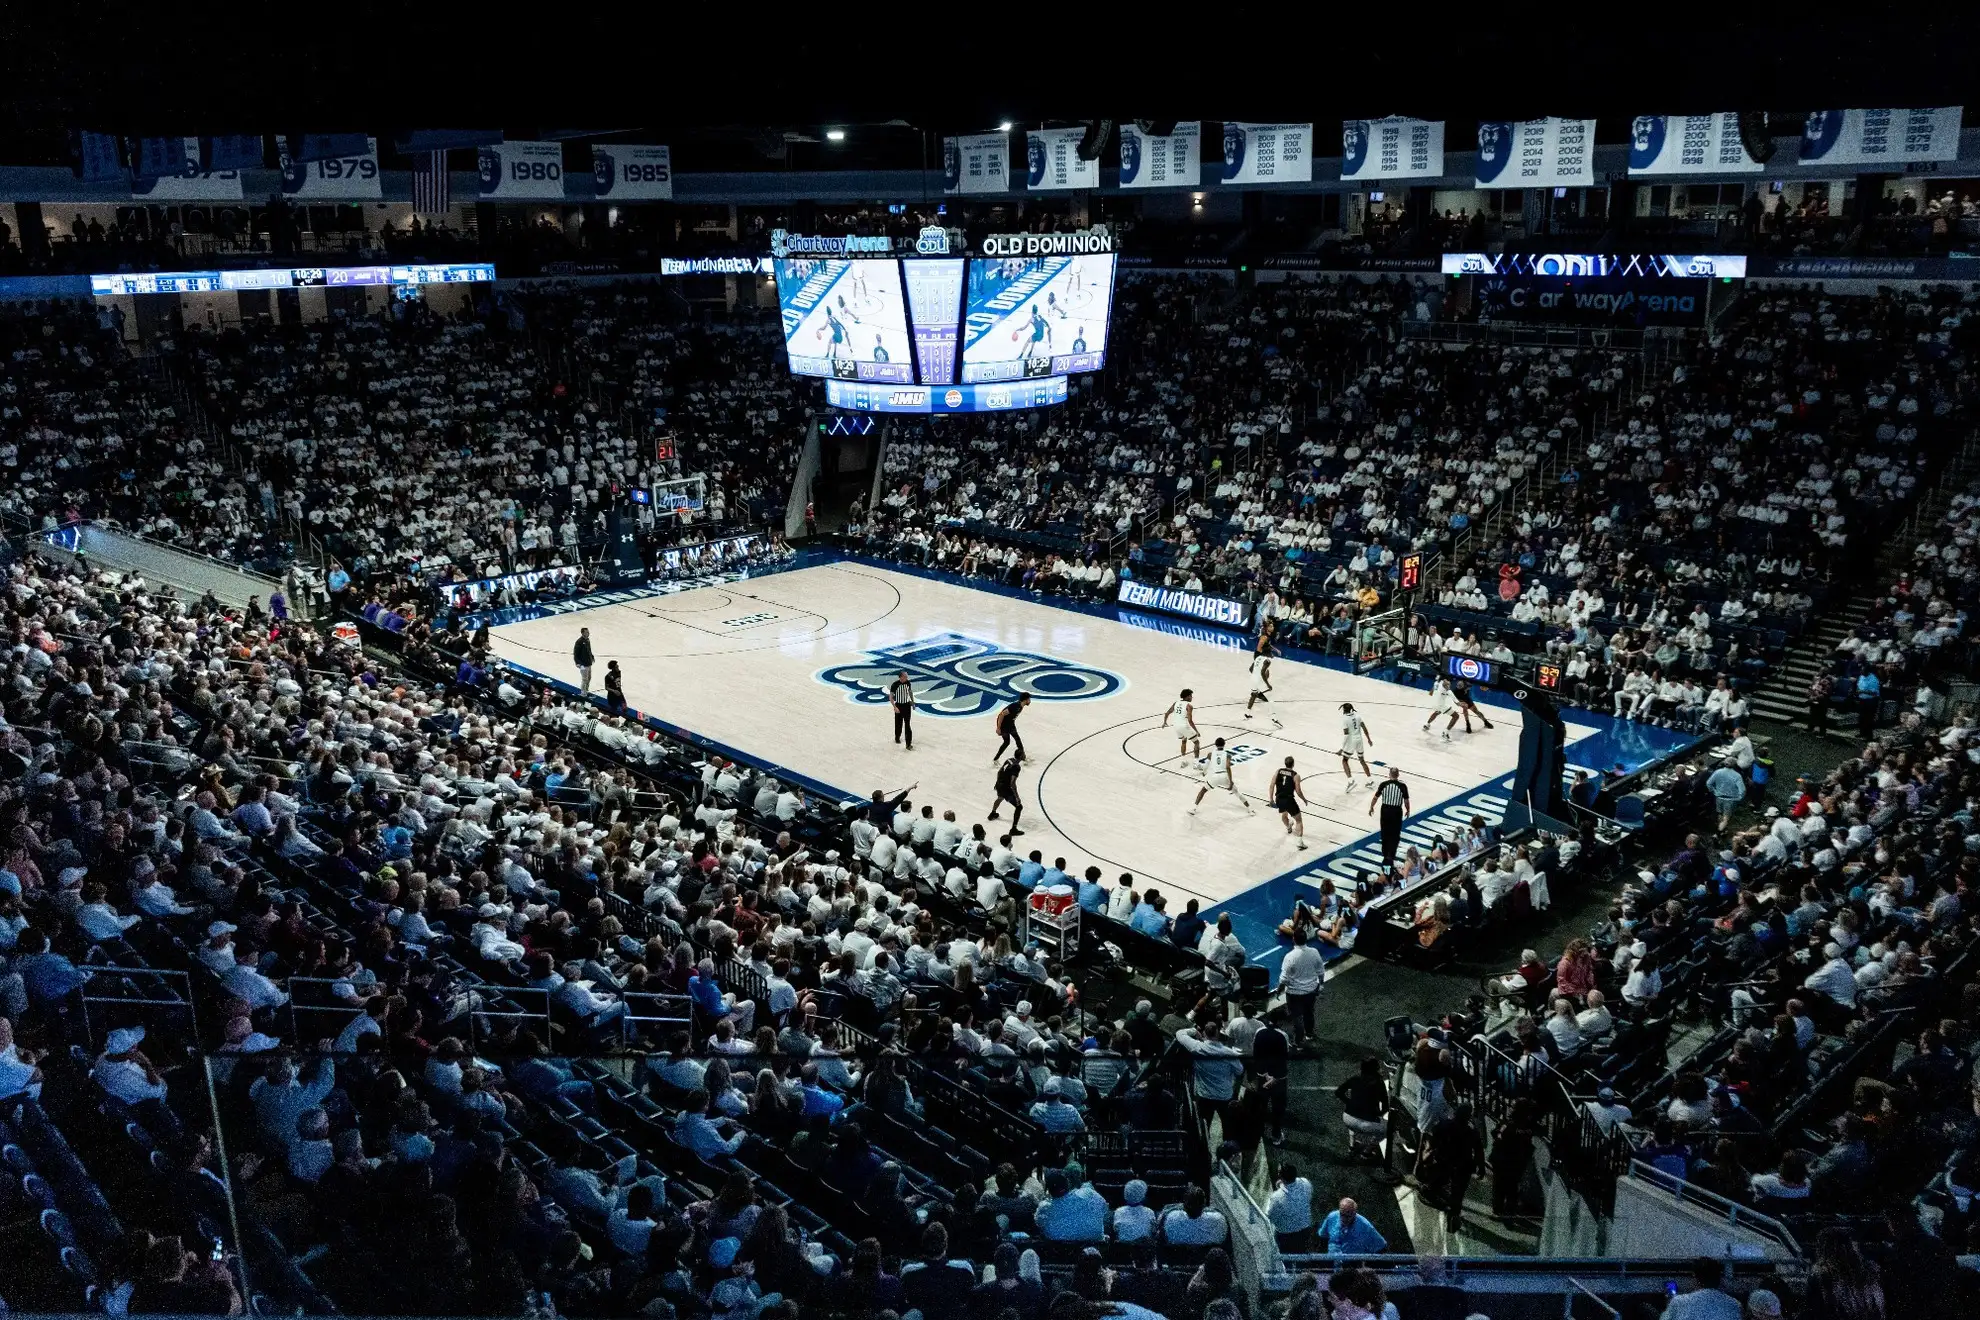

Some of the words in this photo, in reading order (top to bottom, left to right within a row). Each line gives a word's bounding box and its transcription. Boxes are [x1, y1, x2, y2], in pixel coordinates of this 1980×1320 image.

[1411, 125, 1429, 133] 1992
[1524, 127, 1545, 136] 2019
[1560, 125, 1585, 134] 2008
[1685, 123, 1712, 131] 2002
[1524, 137, 1544, 146] 2015
[1559, 136, 1584, 145] 2007
[1683, 140, 1710, 148] 2000
[1522, 148, 1543, 156] 2014
[1558, 146, 1584, 155] 2006
[1682, 149, 1704, 157] 1999
[1720, 147, 1742, 155] 1993
[1522, 159, 1542, 167] 2013
[1557, 157, 1582, 165] 2005
[1681, 157, 1703, 165] 1998
[1719, 156, 1742, 164] 1992
[318, 159, 377, 179] 1979
[511, 161, 560, 180] 1980
[623, 164, 669, 182] 1985
[1556, 167, 1582, 175] 2004
[787, 234, 889, 257] ChartwayArena
[917, 238, 949, 253] ODU
[983, 237, 1022, 255] OLD
[1027, 235, 1111, 253] DOMINION
[692, 257, 752, 272] MONARCH
[1460, 259, 1484, 272] ODU
[1688, 262, 1716, 277] ODU
[271, 273, 286, 284] 10
[295, 269, 323, 279] 10:29
[332, 271, 348, 283] 20
[1027, 357, 1050, 369] 10:29
[1057, 358, 1069, 371] 20
[861, 364, 875, 378] 20
[1005, 364, 1018, 377] 10
[888, 391, 926, 406] JMU
[986, 393, 1012, 408] ODU
[658, 448, 673, 459] 21
[1403, 569, 1418, 588] 21
[1160, 590, 1242, 625] MONARCH
[1541, 675, 1556, 687] 21
